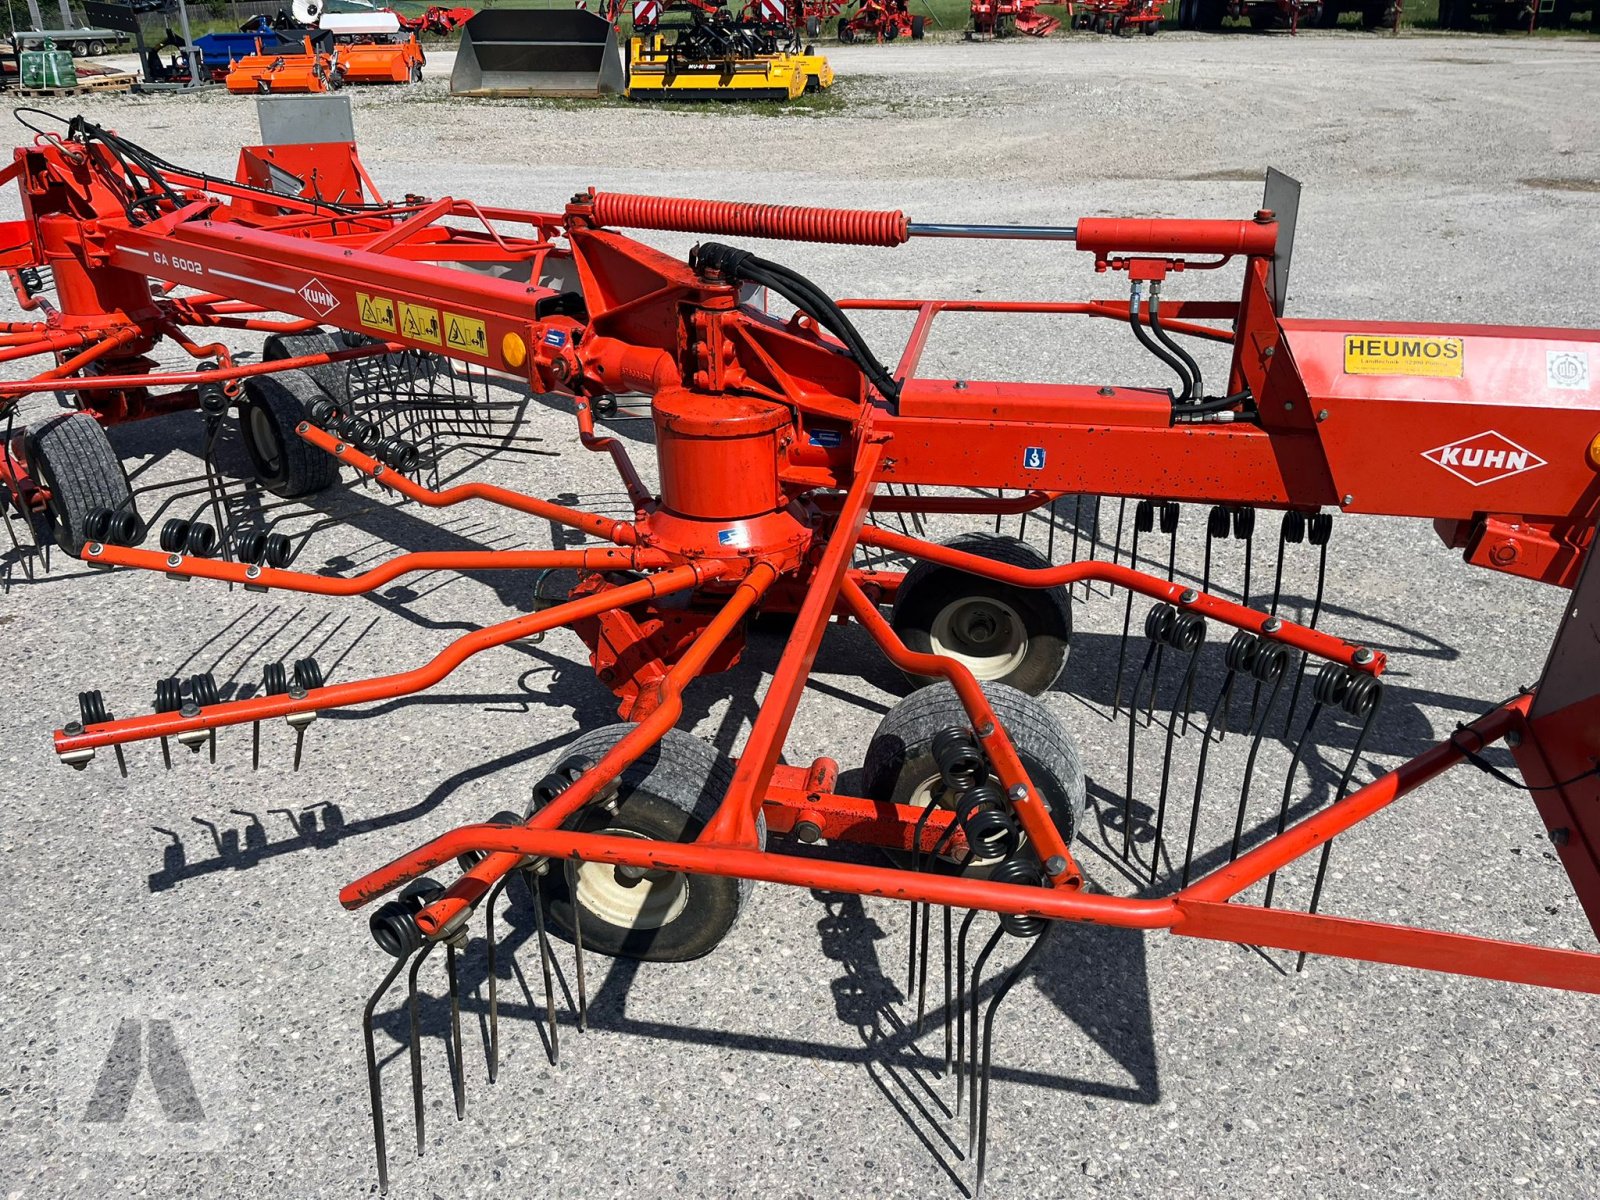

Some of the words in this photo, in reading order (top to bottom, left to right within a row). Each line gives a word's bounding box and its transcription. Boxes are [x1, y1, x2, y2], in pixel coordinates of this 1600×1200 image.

[153, 251, 169, 266] GA
[172, 256, 203, 275] 6002
[303, 288, 334, 307] KUHN
[1349, 339, 1458, 358] HEUMOS
[1440, 446, 1529, 470] KUHN
